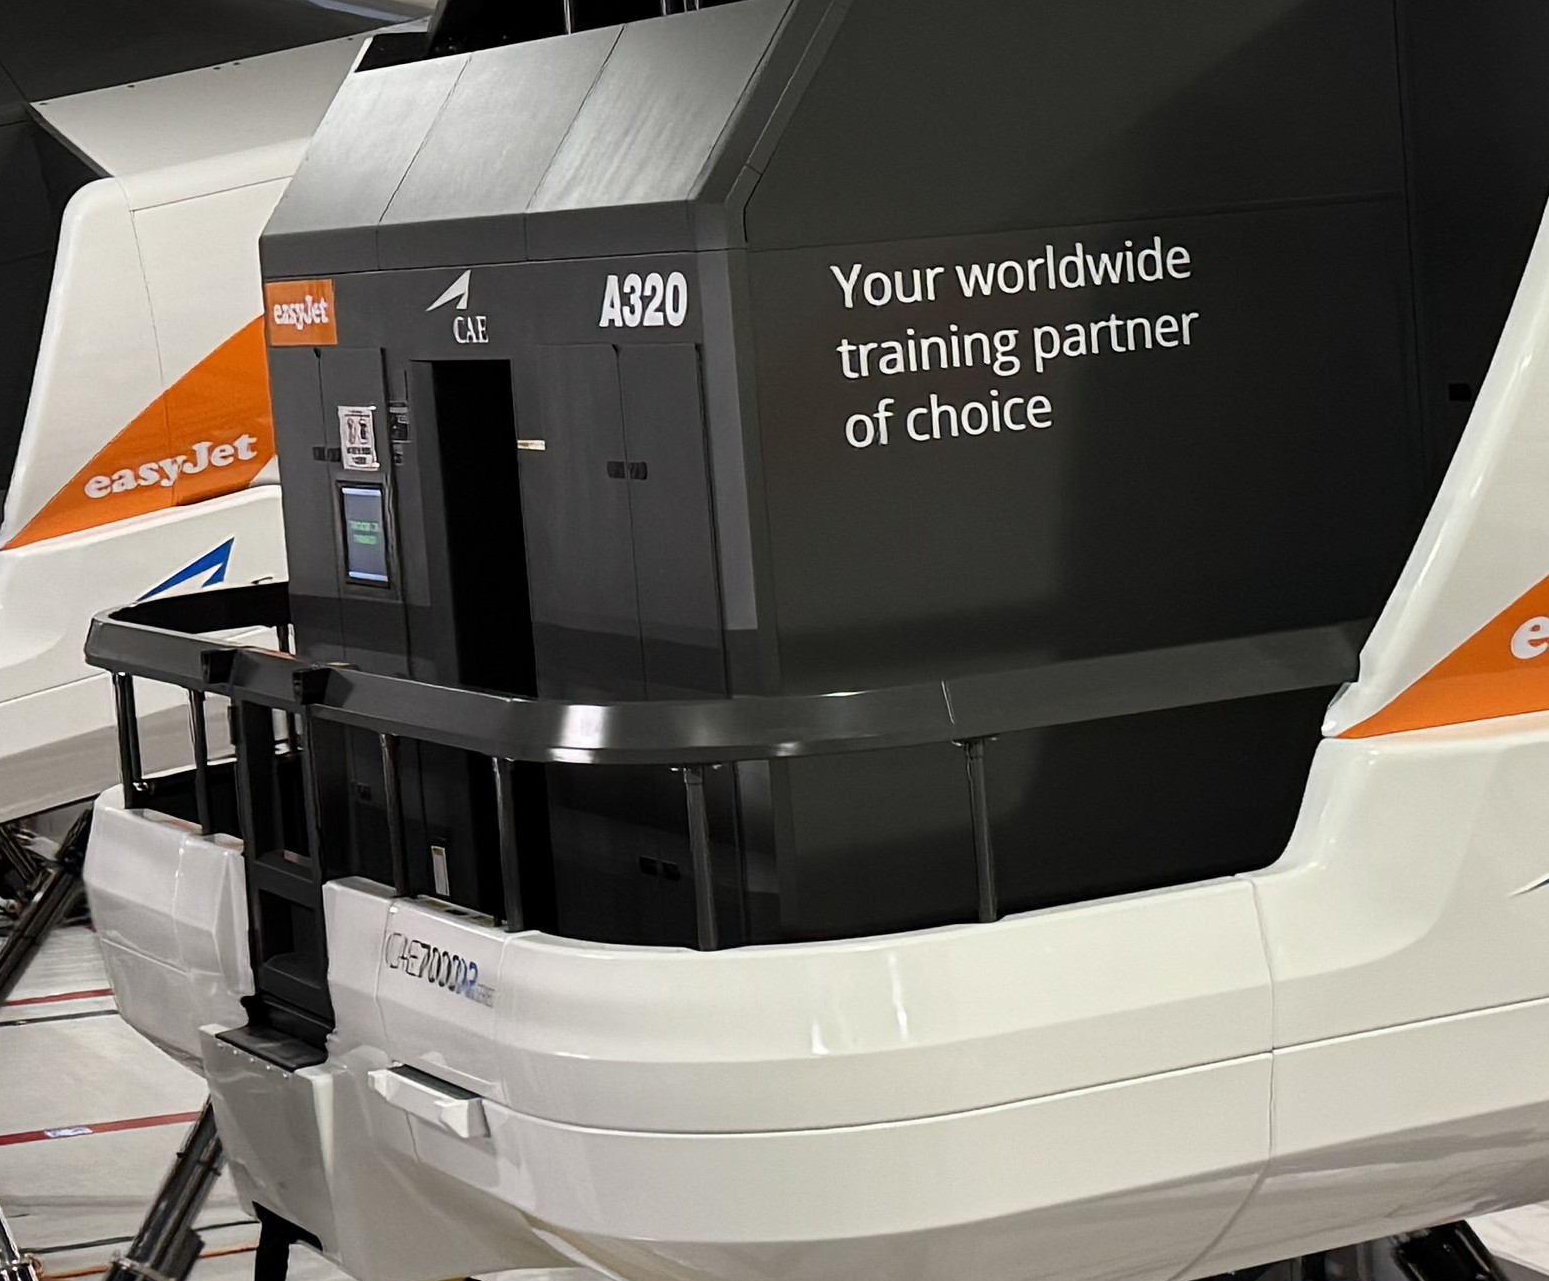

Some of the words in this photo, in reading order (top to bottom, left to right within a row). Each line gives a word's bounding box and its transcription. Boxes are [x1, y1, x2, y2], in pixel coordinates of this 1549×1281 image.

[599, 271, 688, 328] A320
[830, 263, 945, 309] Your
[955, 235, 1192, 298] worldwide
[273, 294, 330, 331] easyJet
[453, 315, 490, 344] CAE
[835, 324, 1021, 379] training
[1033, 311, 1200, 373] partner
[844, 398, 896, 448] of
[906, 389, 1053, 442] choice
[83, 433, 258, 499] easyJet
